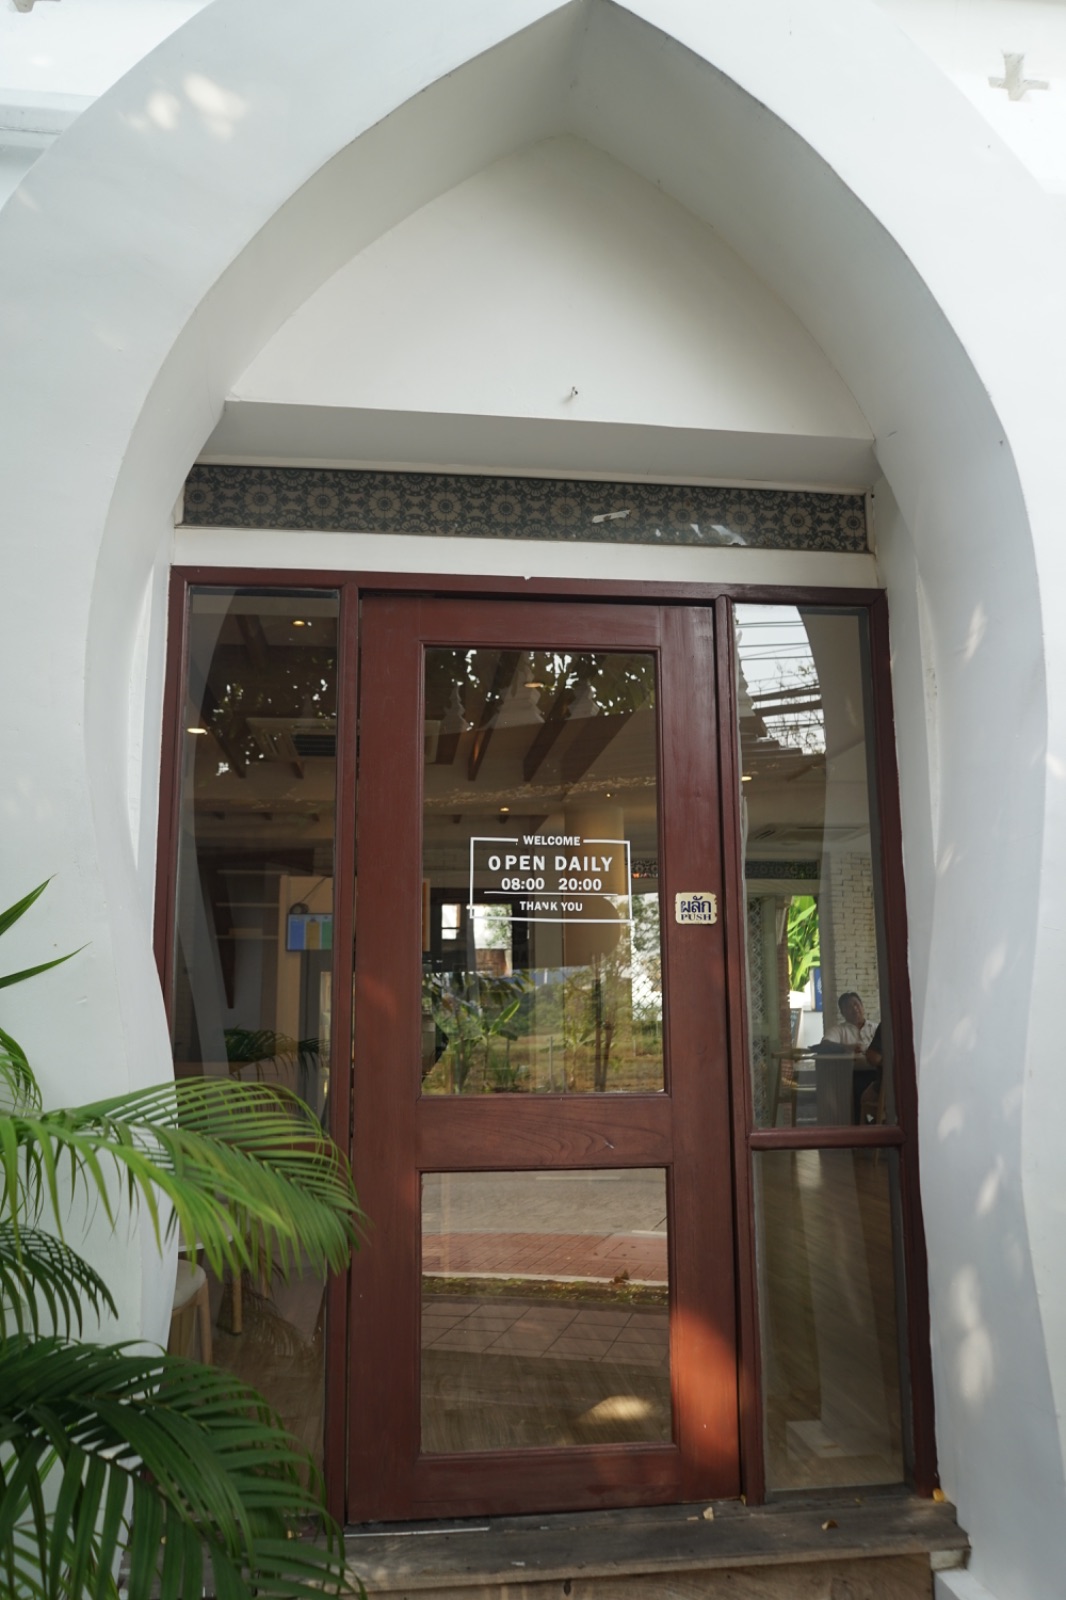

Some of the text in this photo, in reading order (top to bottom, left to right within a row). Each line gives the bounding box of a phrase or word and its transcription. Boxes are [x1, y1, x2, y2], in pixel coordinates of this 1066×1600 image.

[523, 835, 581, 846] WELCOME
[488, 855, 613, 872] OPEN DAILY
[501, 877, 602, 891] 08:00 20:00
[519, 901, 583, 912] THANK YOU
[680, 895, 712, 913] ผลัก
[681, 913, 712, 921] PUSH
